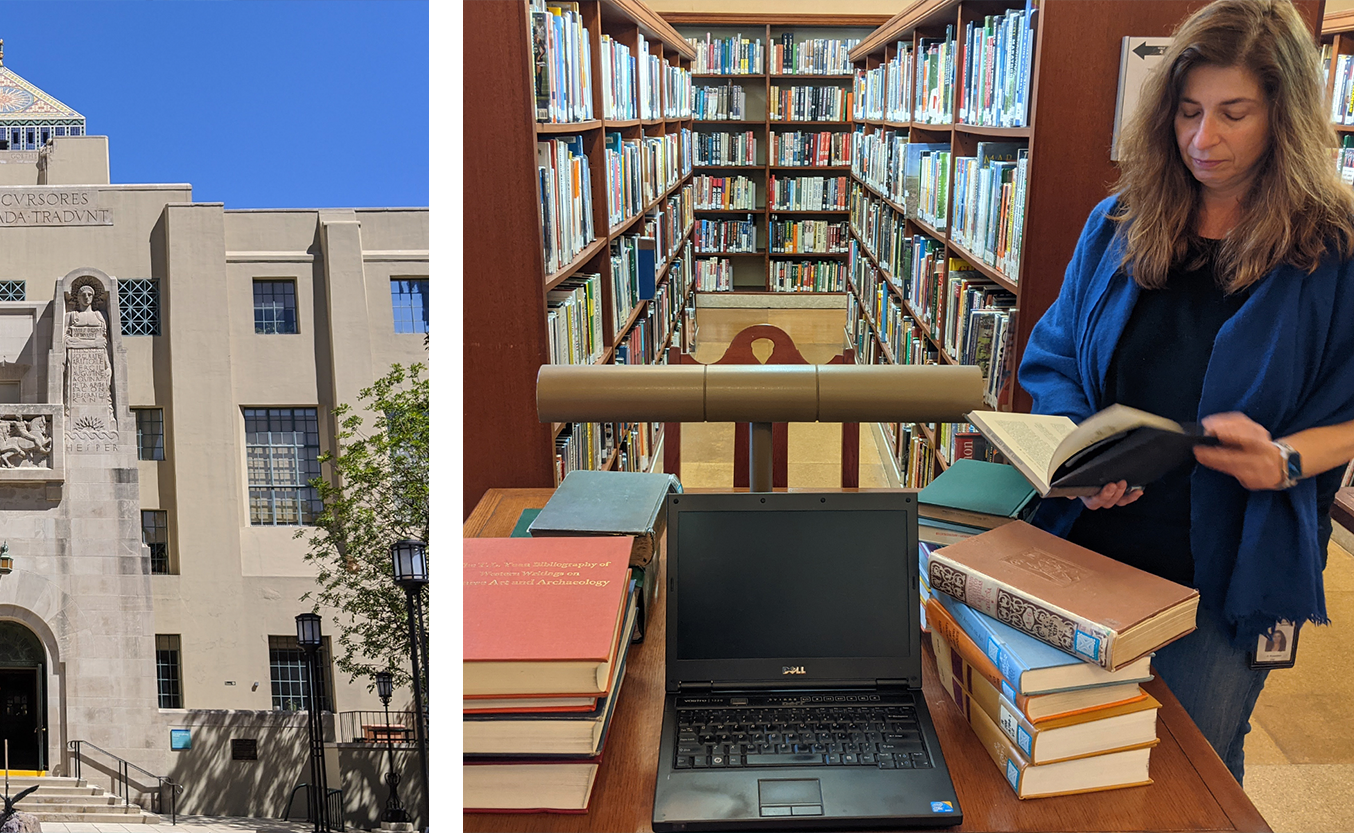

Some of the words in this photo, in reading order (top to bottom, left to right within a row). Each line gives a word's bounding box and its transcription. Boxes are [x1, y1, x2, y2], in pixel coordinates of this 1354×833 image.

[1, 193, 88, 206] CVRSORES
[32, 210, 108, 223] TRADVNT
[533, 561, 597, 569] Bibliography
[537, 579, 610, 587] Archaeology
[782, 666, 806, 675] DELL
